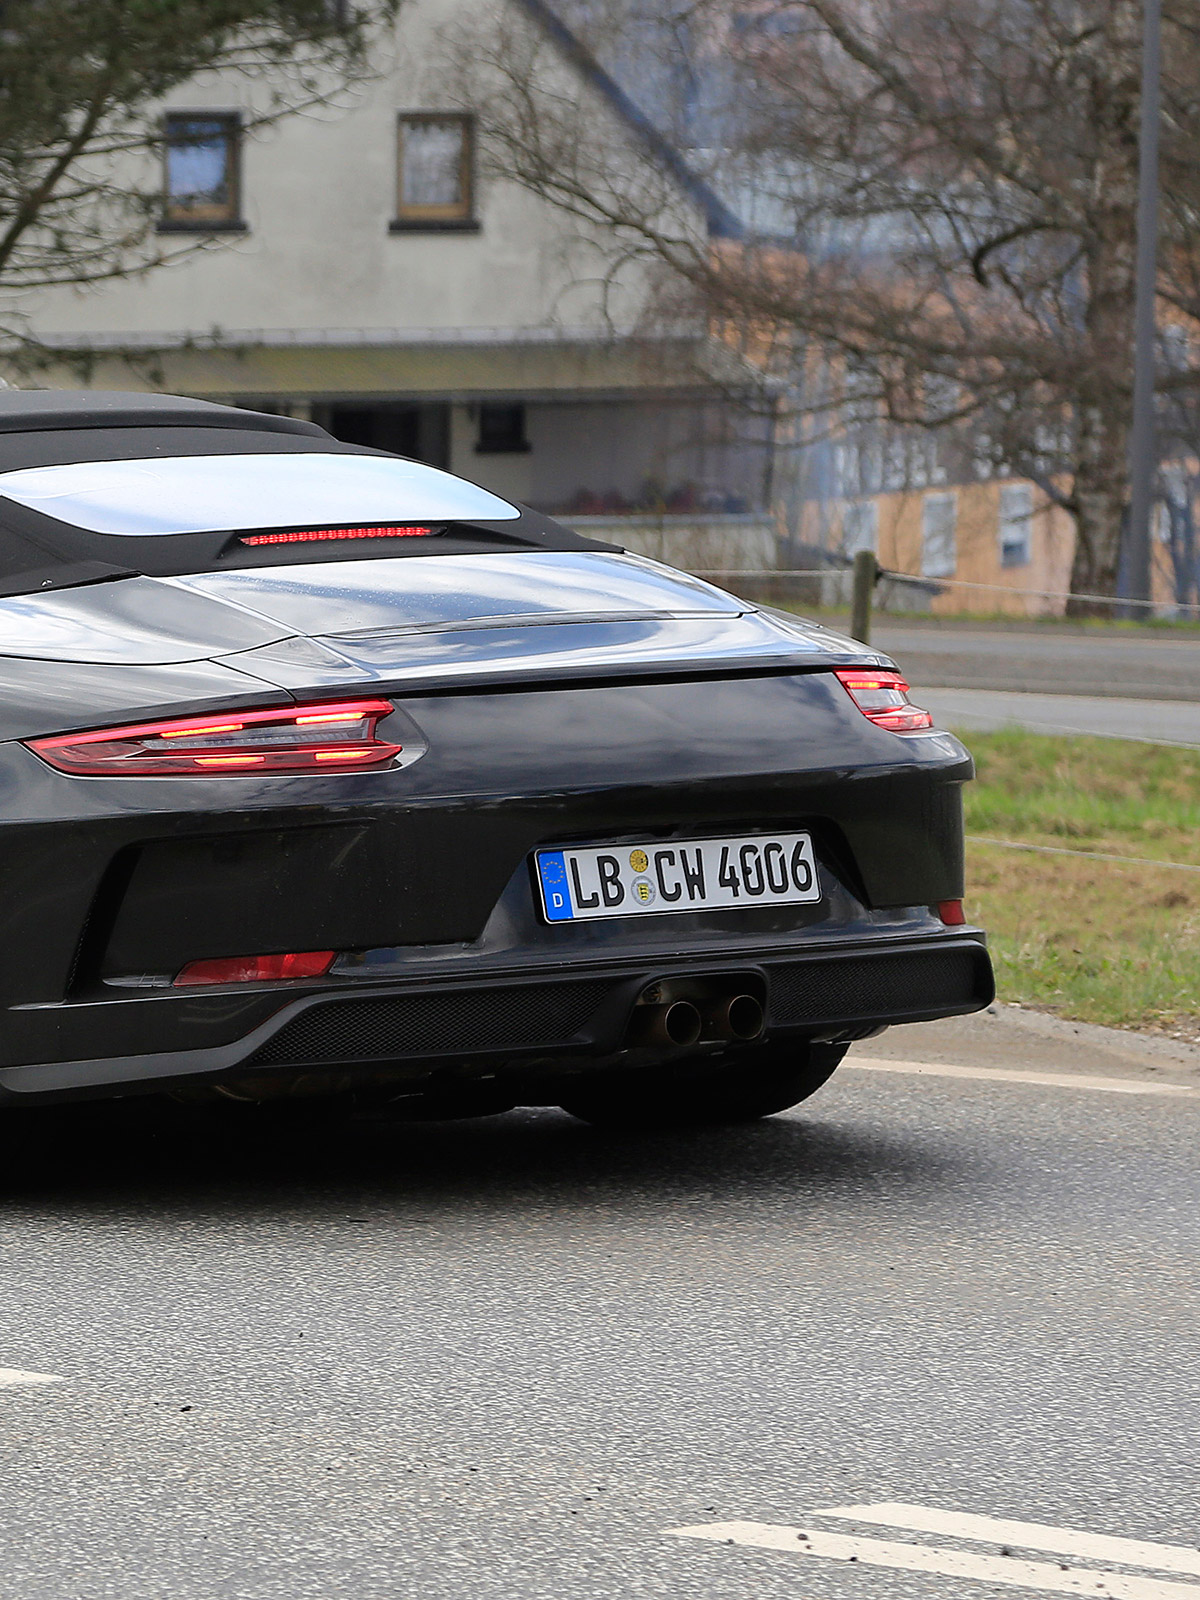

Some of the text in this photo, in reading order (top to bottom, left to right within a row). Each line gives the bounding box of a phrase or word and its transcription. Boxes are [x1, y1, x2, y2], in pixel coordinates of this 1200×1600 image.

[569, 840, 812, 909] LB CW 4006
[552, 893, 563, 908] D
